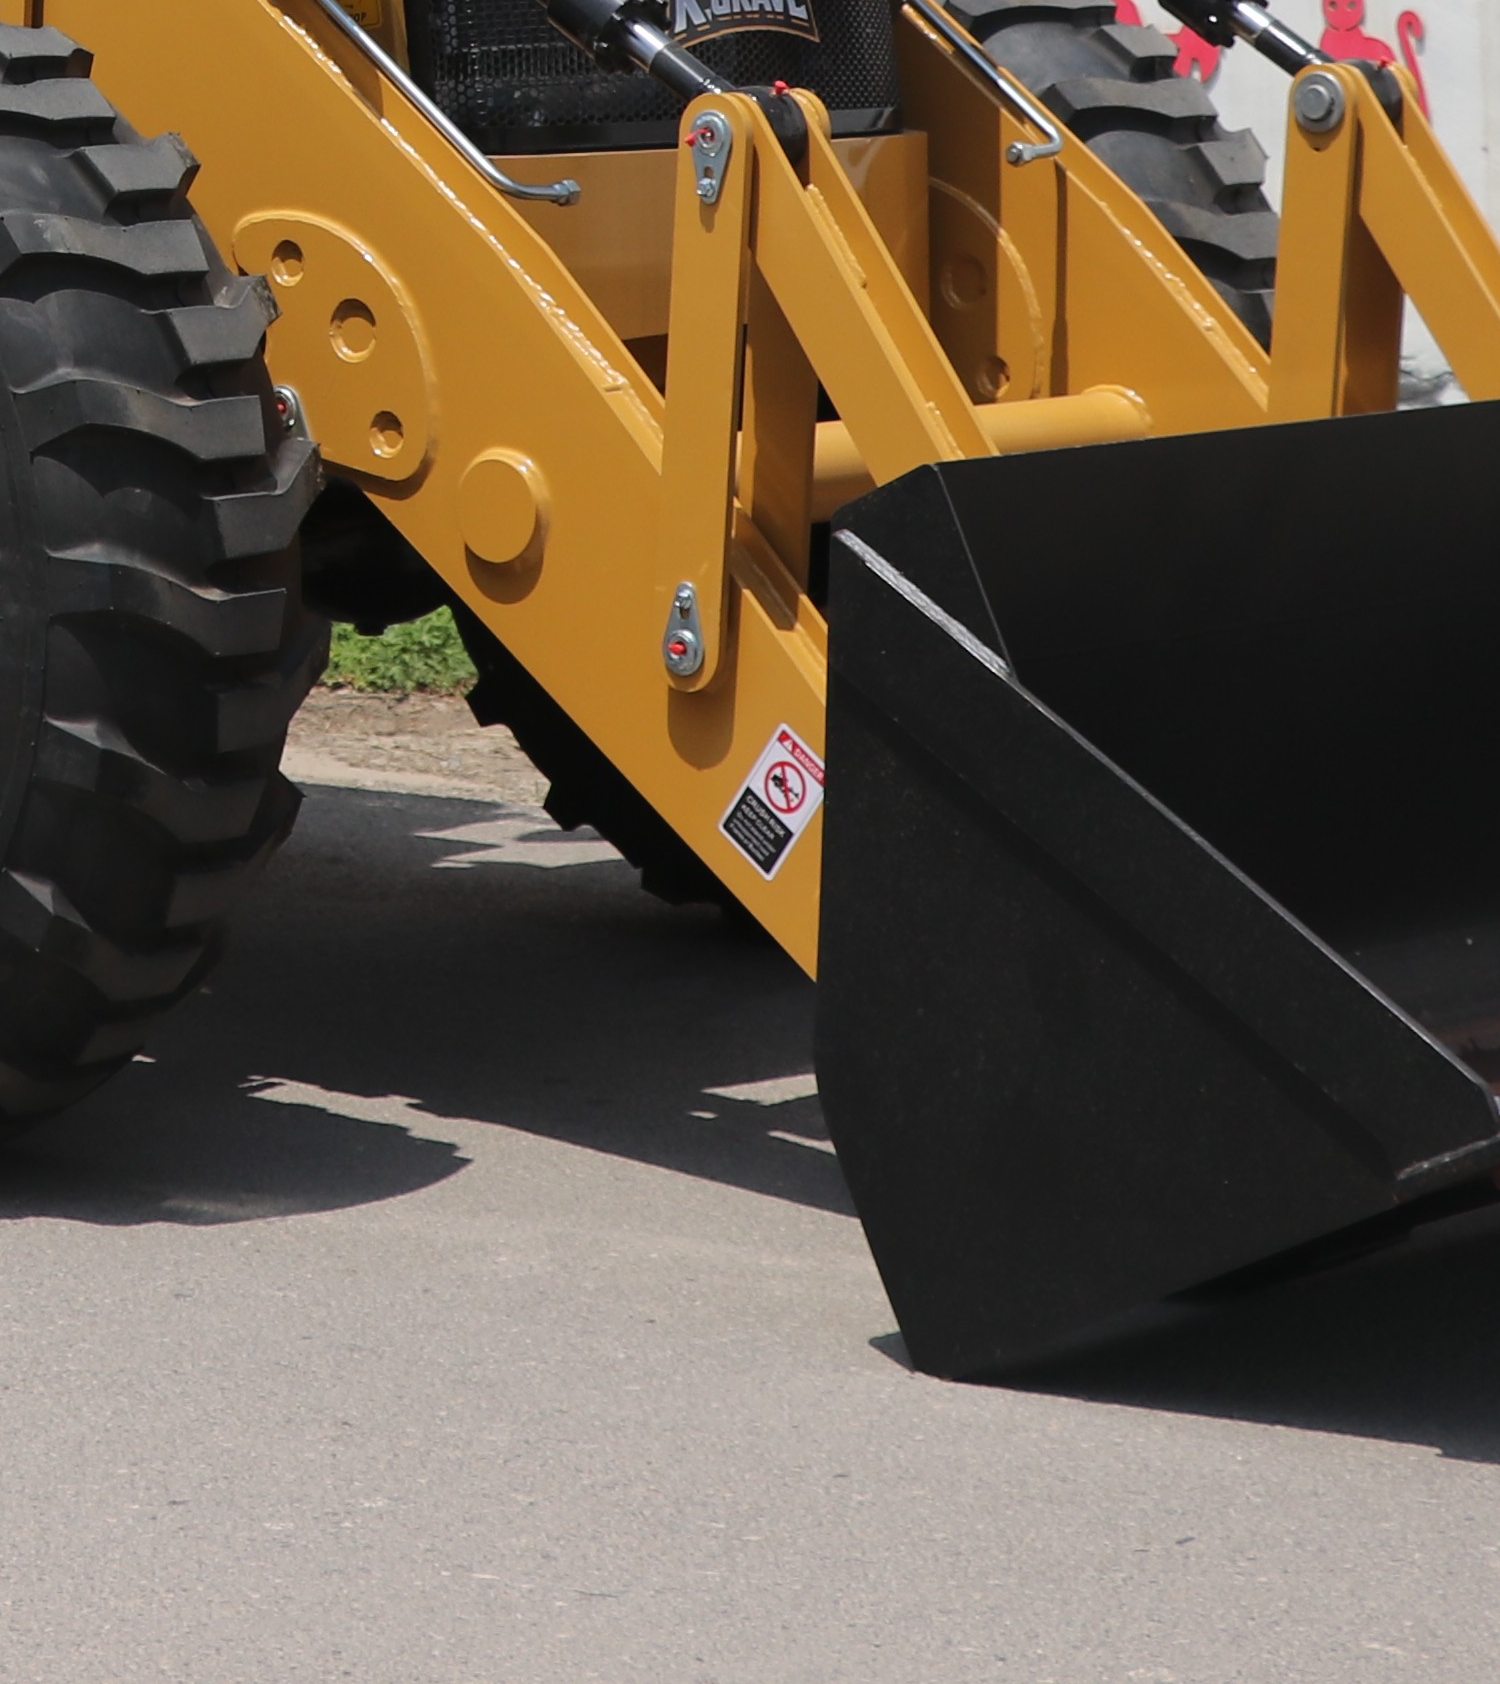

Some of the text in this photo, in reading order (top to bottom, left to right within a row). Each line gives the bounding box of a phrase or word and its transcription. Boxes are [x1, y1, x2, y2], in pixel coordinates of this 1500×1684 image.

[793, 748, 825, 782] DANGER
[746, 794, 771, 821] CRUSH
[768, 816, 786, 838] RISK
